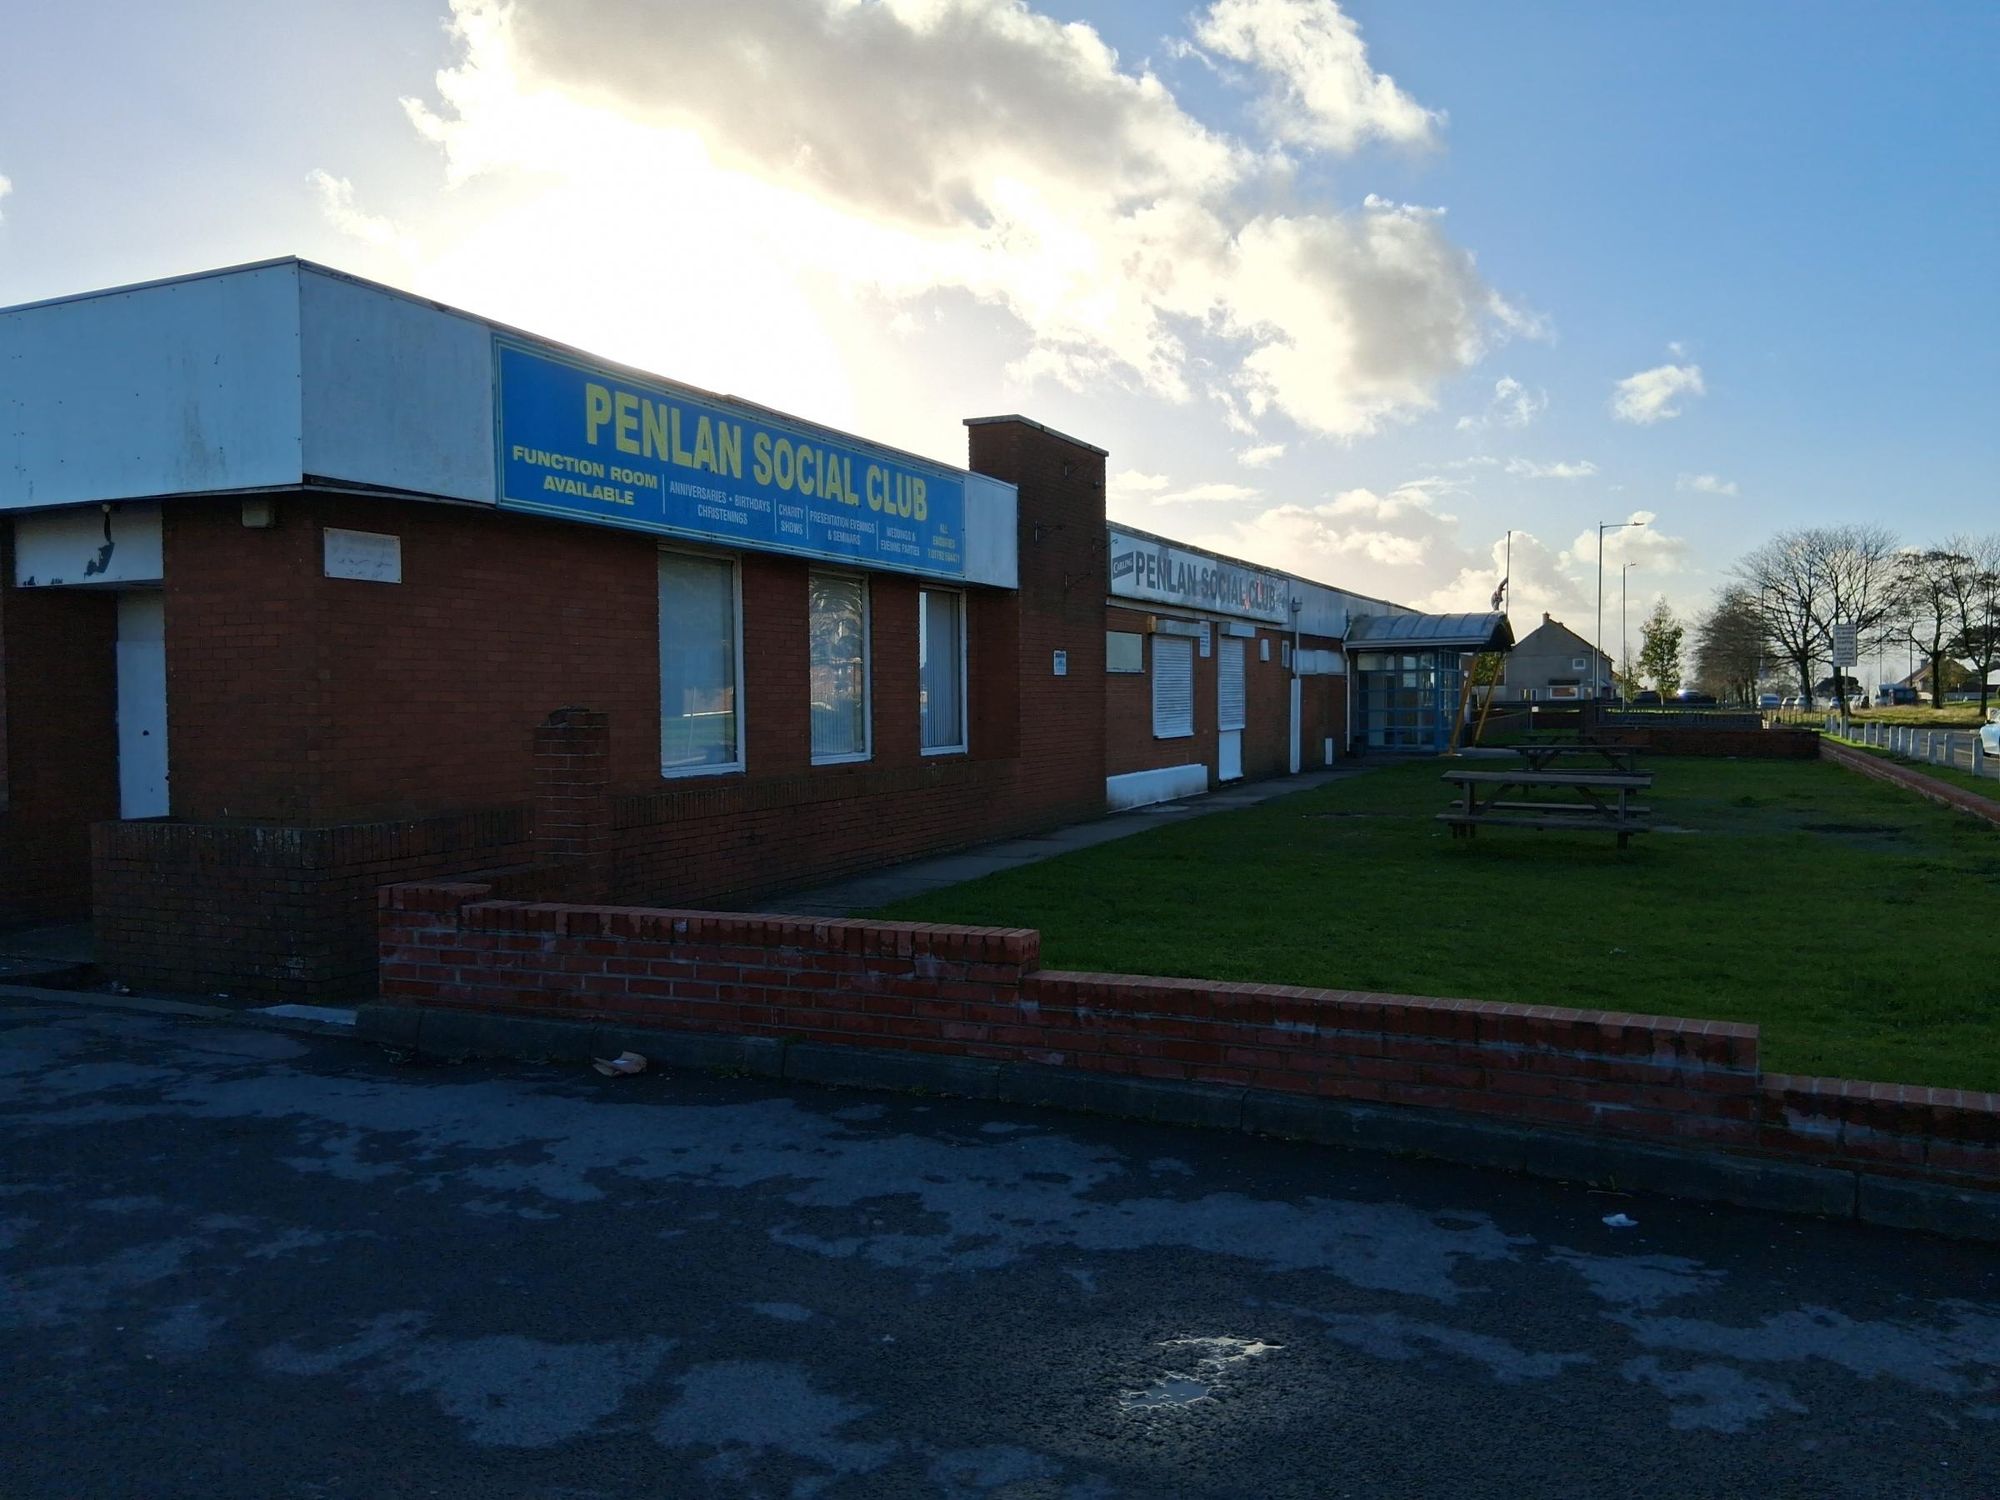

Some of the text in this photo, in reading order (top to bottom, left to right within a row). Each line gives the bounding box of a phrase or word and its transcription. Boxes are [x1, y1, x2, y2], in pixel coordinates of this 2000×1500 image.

[586, 383, 928, 521] PENLAN SOCIAL CLUB
[512, 445, 658, 489] FUNCTION ROOM
[544, 476, 635, 505] AVAILABLE
[670, 481, 770, 512] ANNIVERSARIES BIRTHDAYS
[698, 505, 748, 525] CHRISTENINGS
[779, 504, 803, 519] CHARITY
[810, 510, 875, 534] PRESENTATION EVENINGS
[781, 520, 803, 535] SHOWS
[833, 530, 860, 545] SEMINARS
[1136, 550, 1276, 611] PENLAN SOCIAL CLUB
